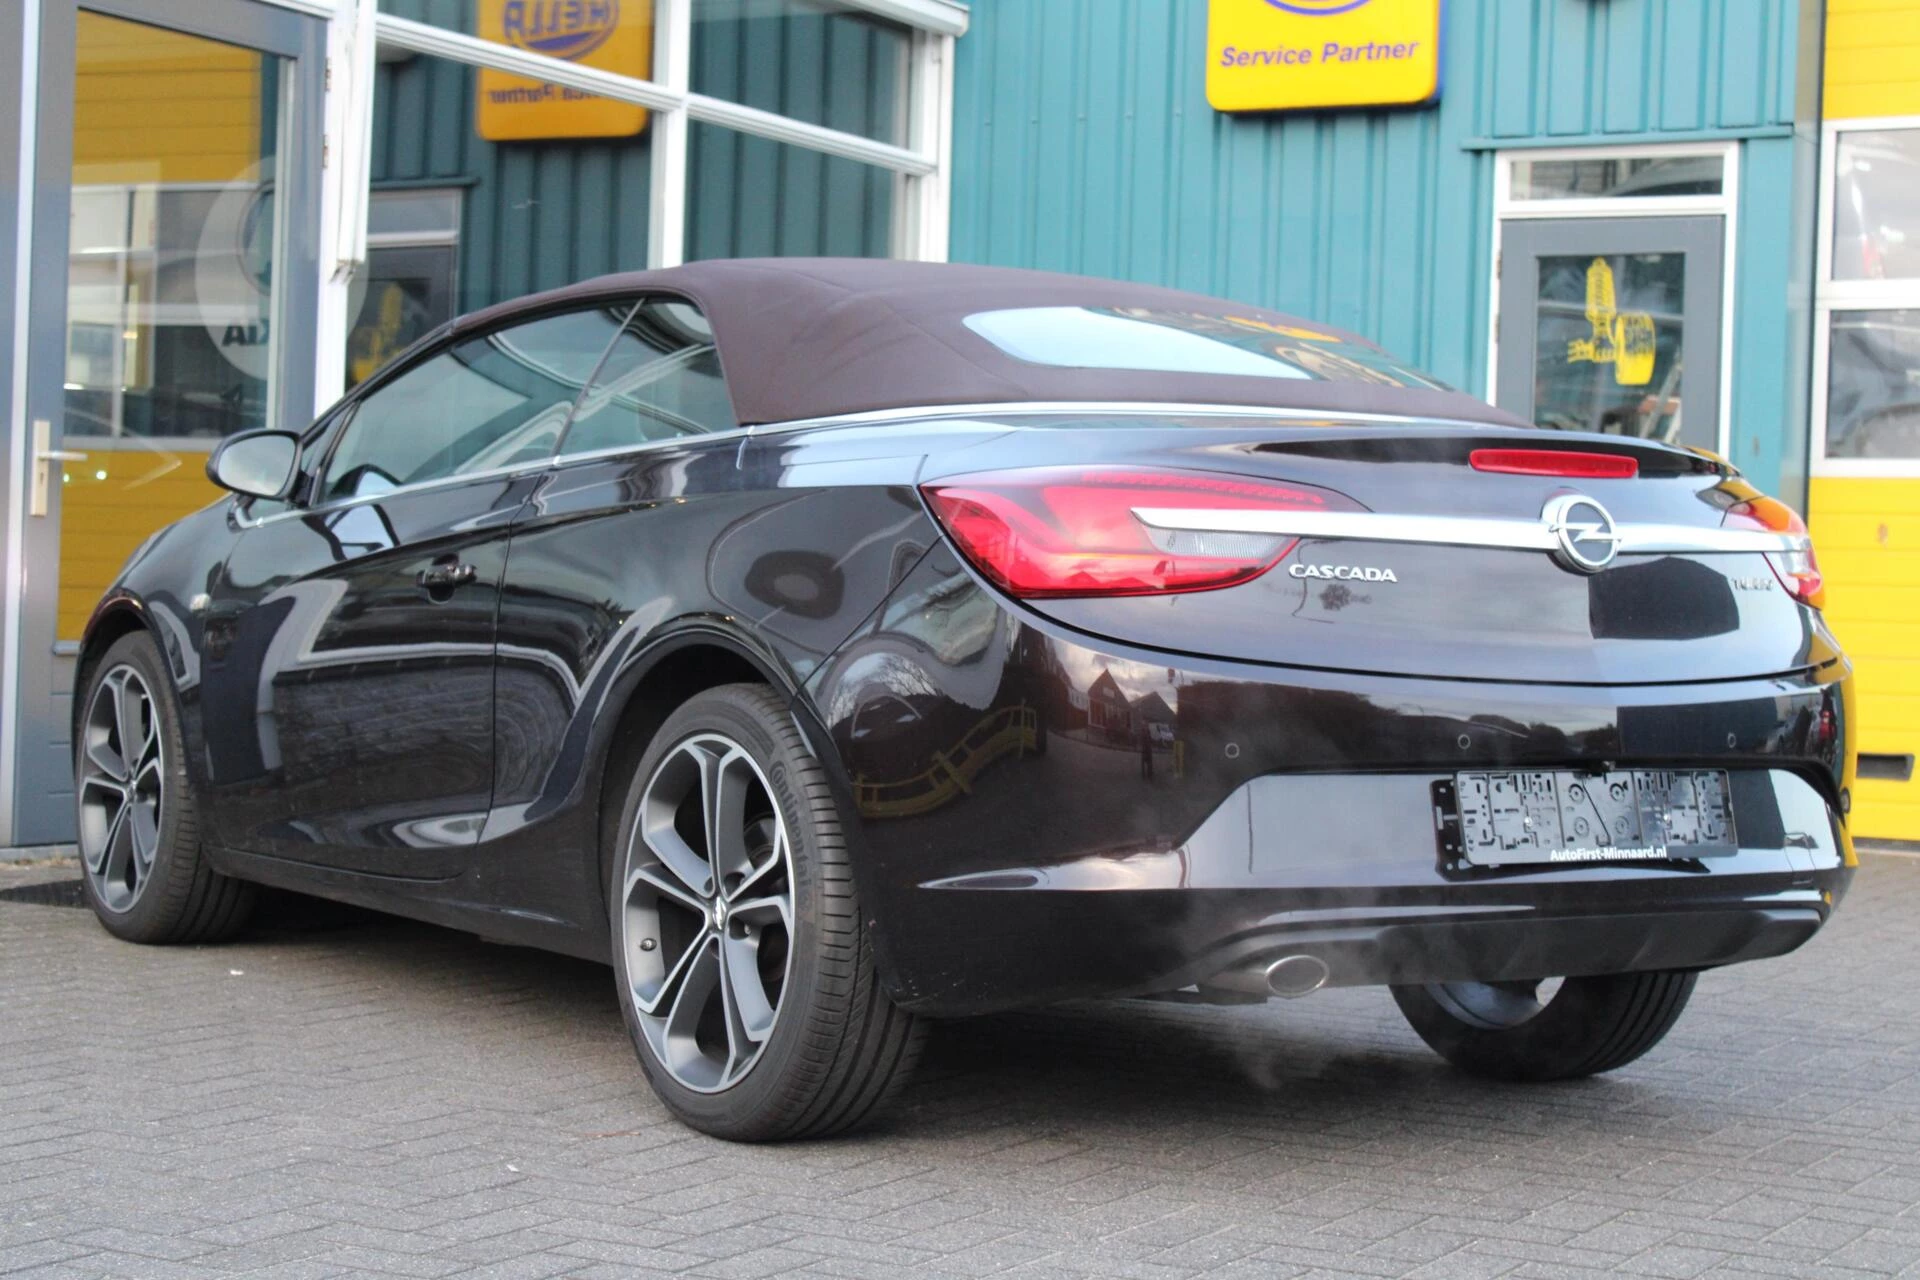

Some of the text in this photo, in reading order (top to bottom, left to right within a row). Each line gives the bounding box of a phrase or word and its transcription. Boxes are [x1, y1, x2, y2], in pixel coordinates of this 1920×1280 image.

[1220, 41, 1420, 67] Service Partner
[1288, 563, 1398, 583] CASCADA
[769, 760, 812, 886] Continental
[1550, 845, 1668, 861] AutoFirst-Minnaard.nl
